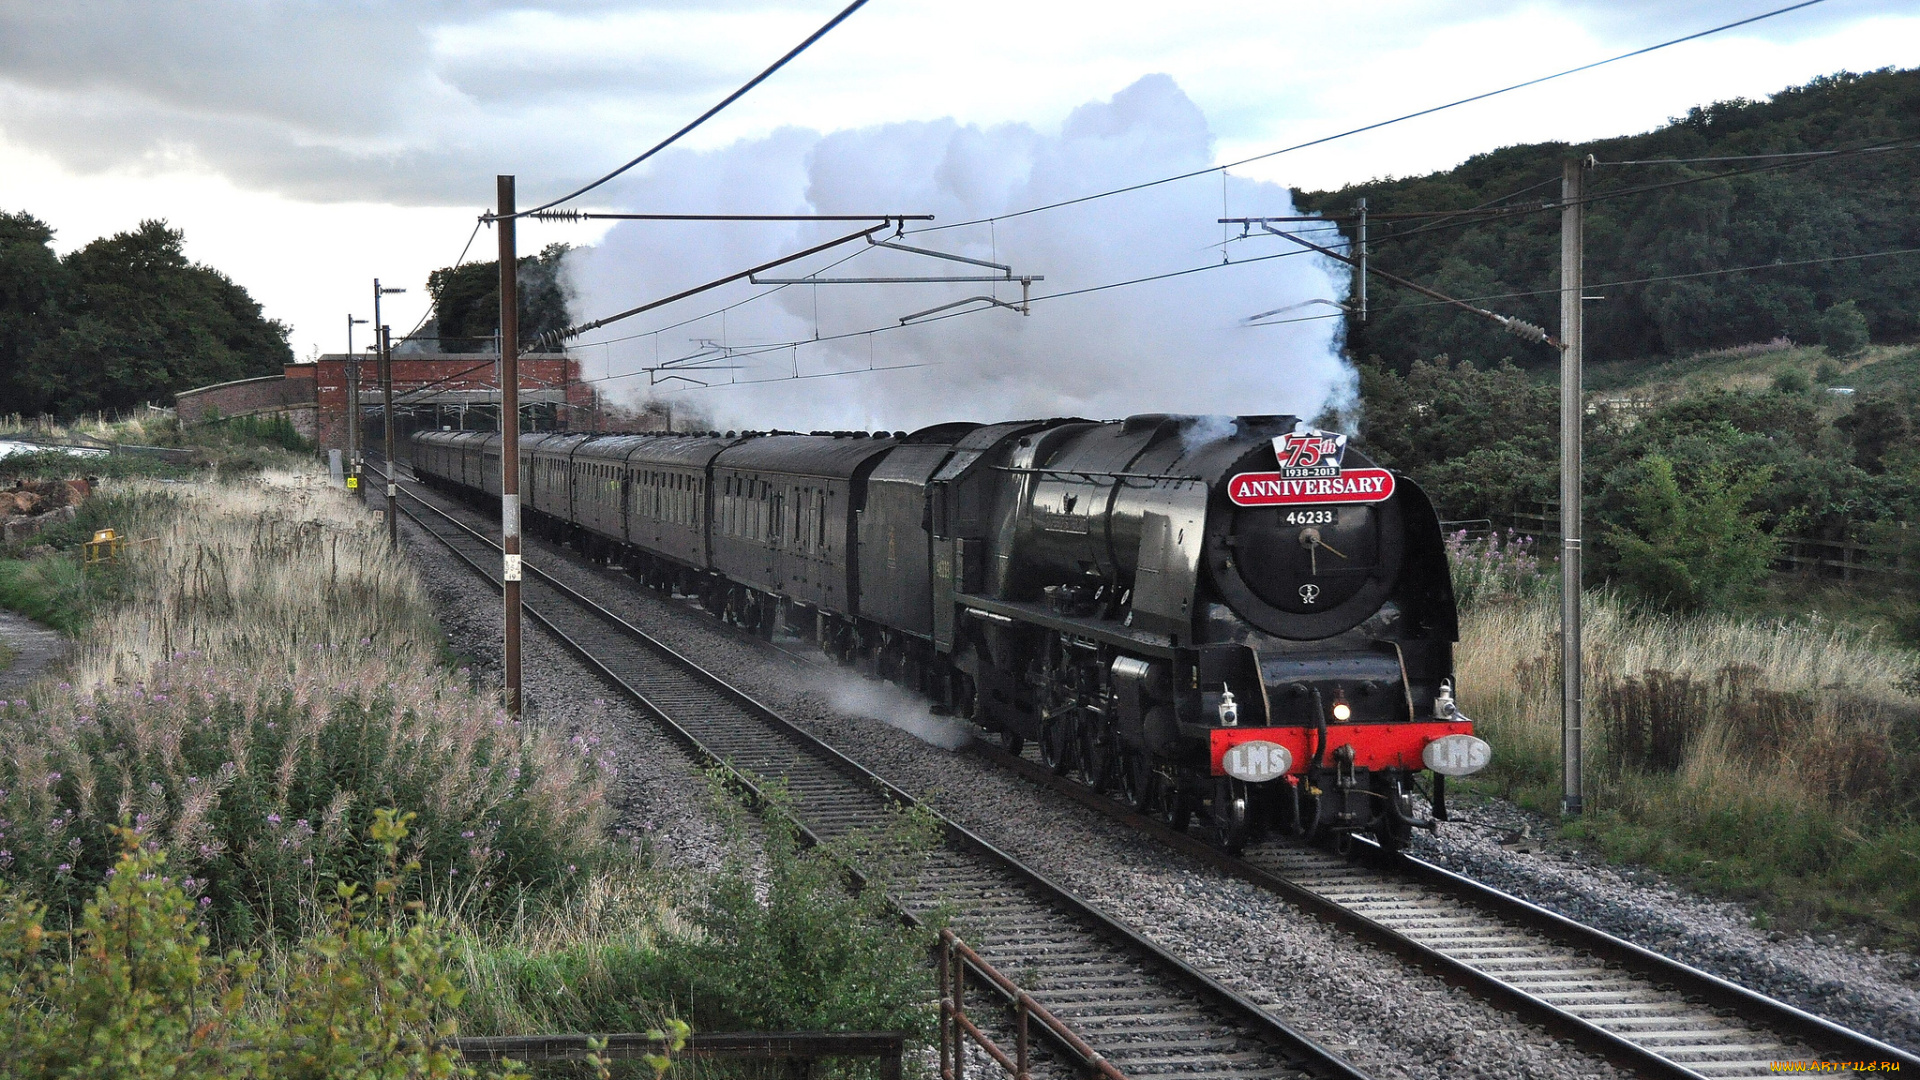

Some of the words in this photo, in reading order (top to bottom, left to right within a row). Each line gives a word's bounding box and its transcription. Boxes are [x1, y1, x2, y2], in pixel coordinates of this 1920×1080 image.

[1286, 438, 1337, 467] 75th
[1237, 477, 1385, 498] ANNIVERSARY
[1286, 511, 1333, 525] 46233
[1231, 747, 1285, 775] LMS
[1432, 739, 1485, 769] LMS
